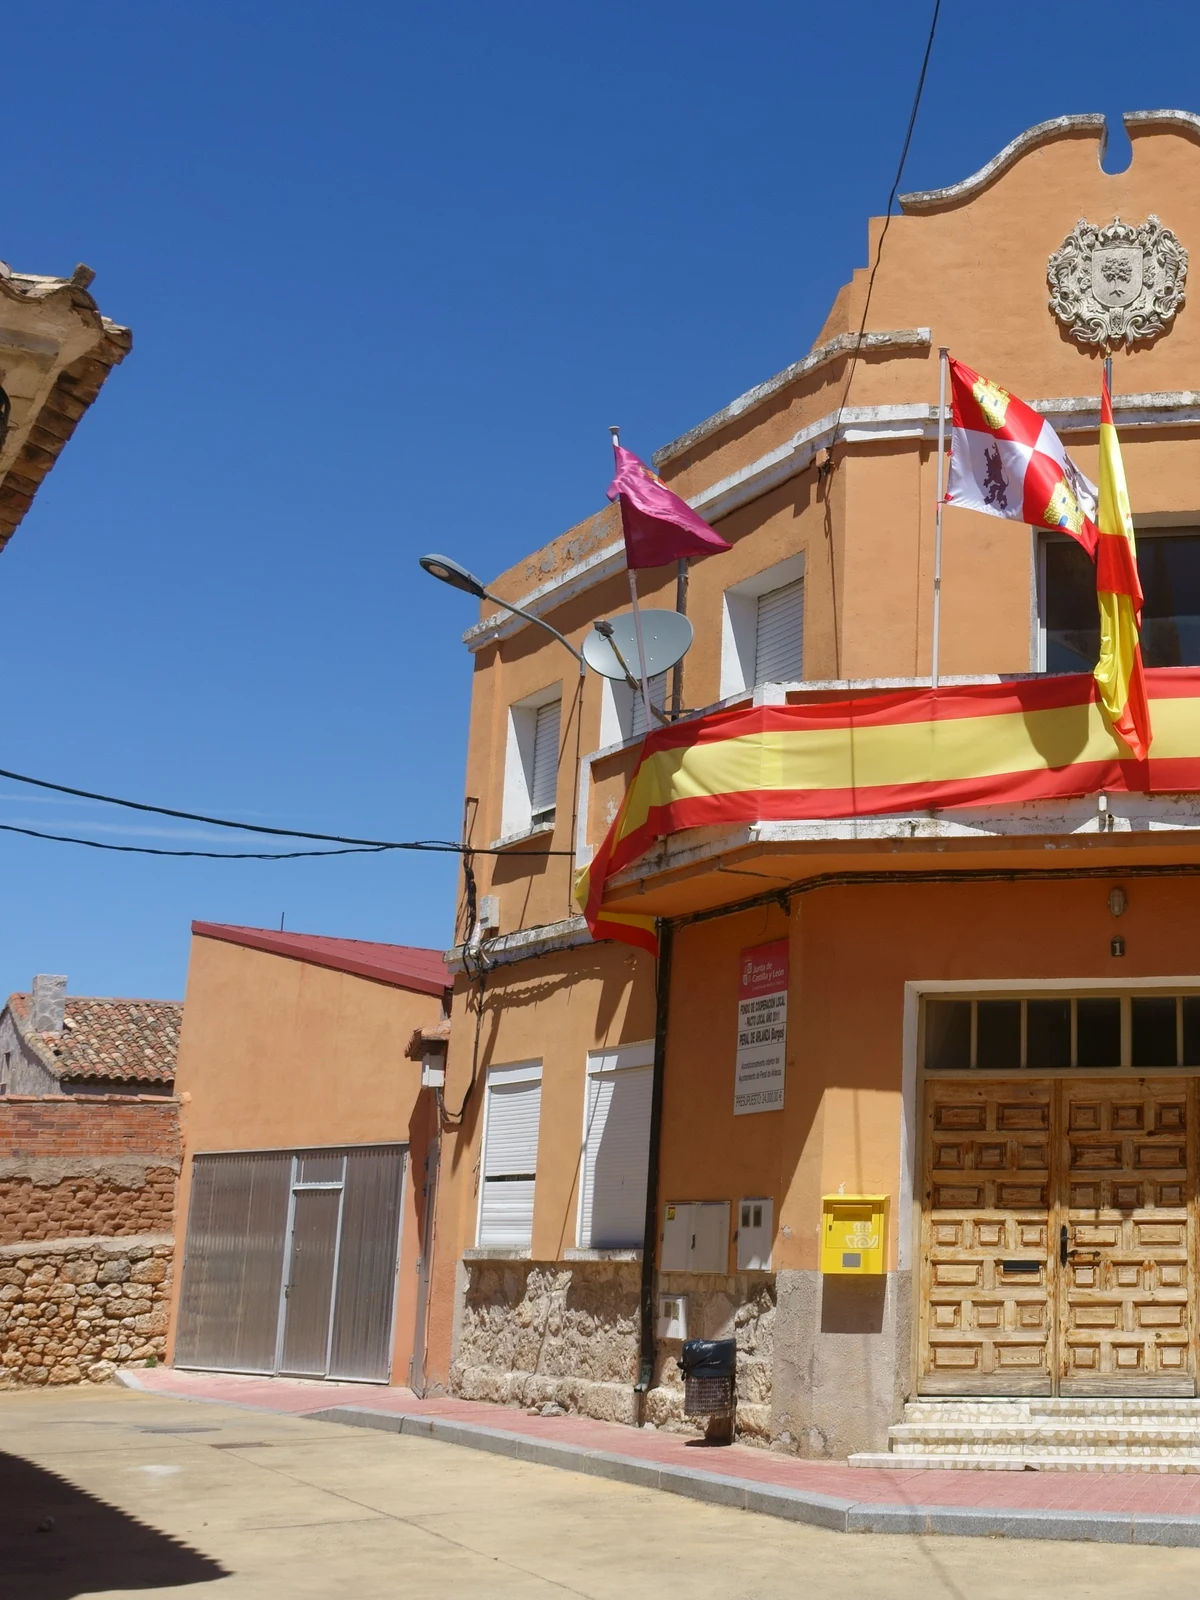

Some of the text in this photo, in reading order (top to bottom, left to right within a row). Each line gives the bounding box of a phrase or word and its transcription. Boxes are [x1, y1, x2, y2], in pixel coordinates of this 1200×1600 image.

[1113, 942, 1122, 956] 1
[753, 962, 772, 973] Junta de
[752, 972, 768, 983] Castilla
[773, 968, 784, 978] León
[740, 1003, 750, 1015] FONDO
[751, 1002, 755, 1013] DE
[776, 996, 785, 1008] LOCAL
